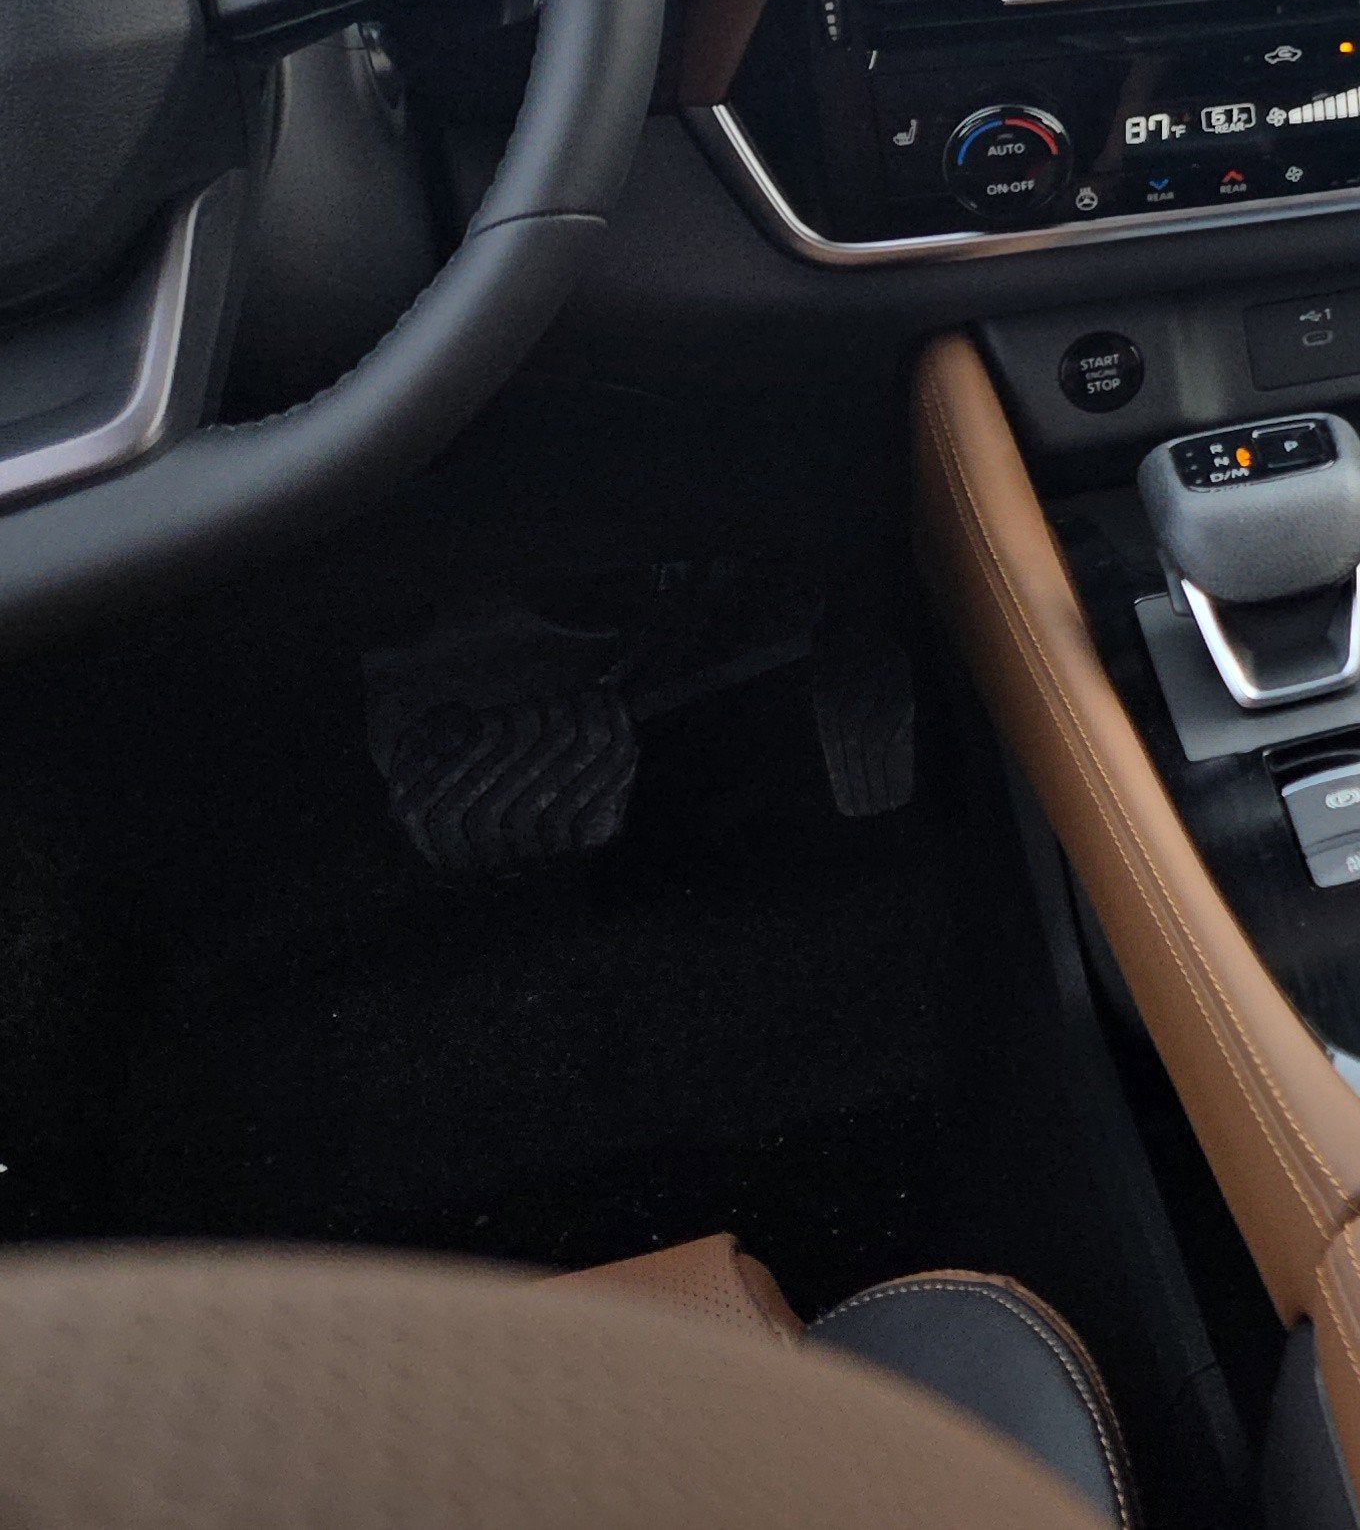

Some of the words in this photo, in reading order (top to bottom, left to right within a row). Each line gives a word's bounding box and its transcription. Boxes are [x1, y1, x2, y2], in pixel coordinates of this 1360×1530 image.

[987, 142, 1026, 157] AUTO
[1323, 308, 1331, 320] 1
[1080, 353, 1120, 371] START
[1086, 377, 1121, 395] STOP
